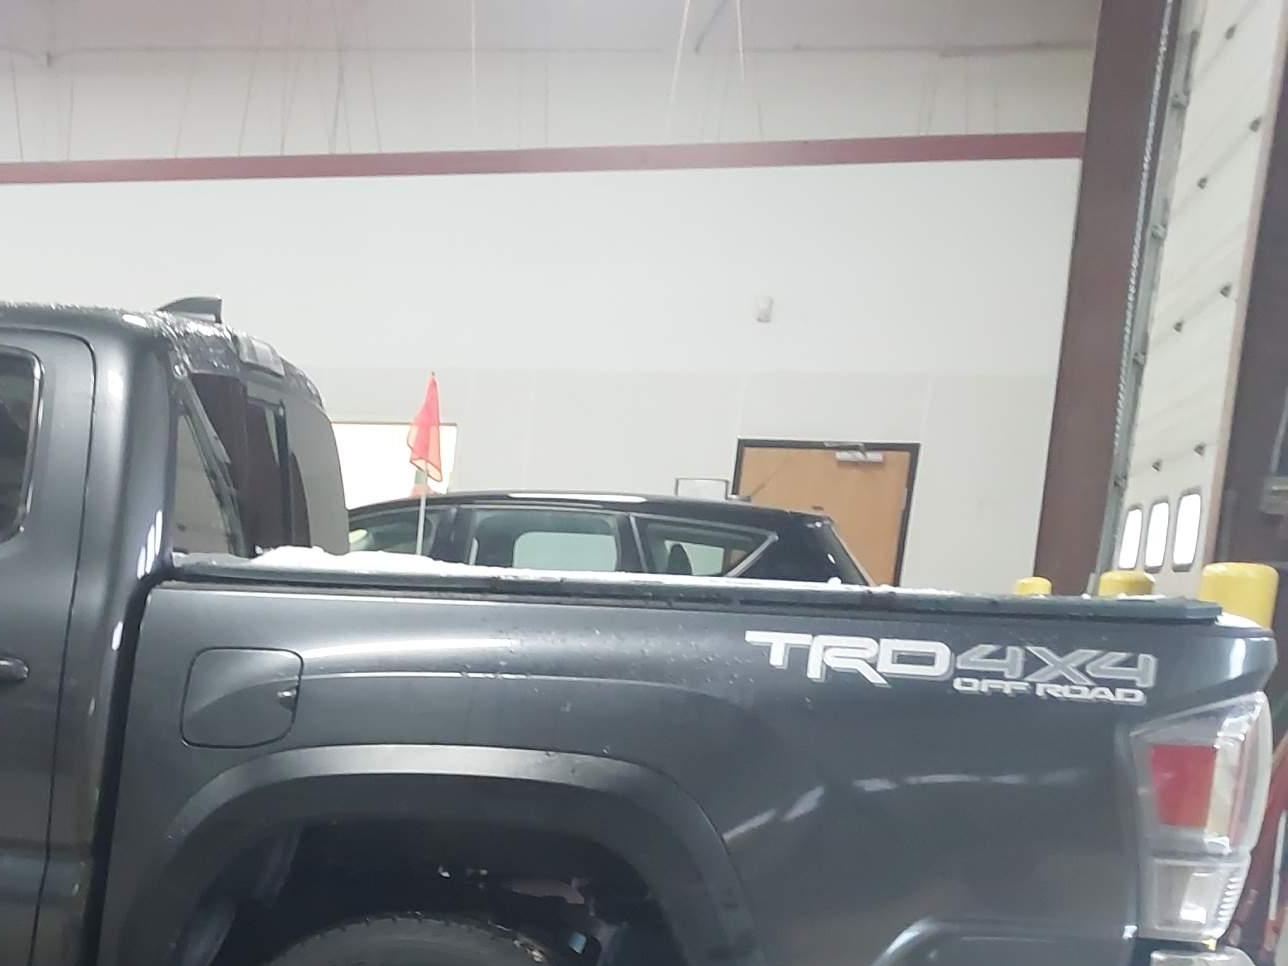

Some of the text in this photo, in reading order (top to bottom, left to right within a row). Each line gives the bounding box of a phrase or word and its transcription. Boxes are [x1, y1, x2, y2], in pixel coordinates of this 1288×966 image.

[744, 630, 955, 687] TRD
[952, 677, 1147, 705] OFF ROAD
